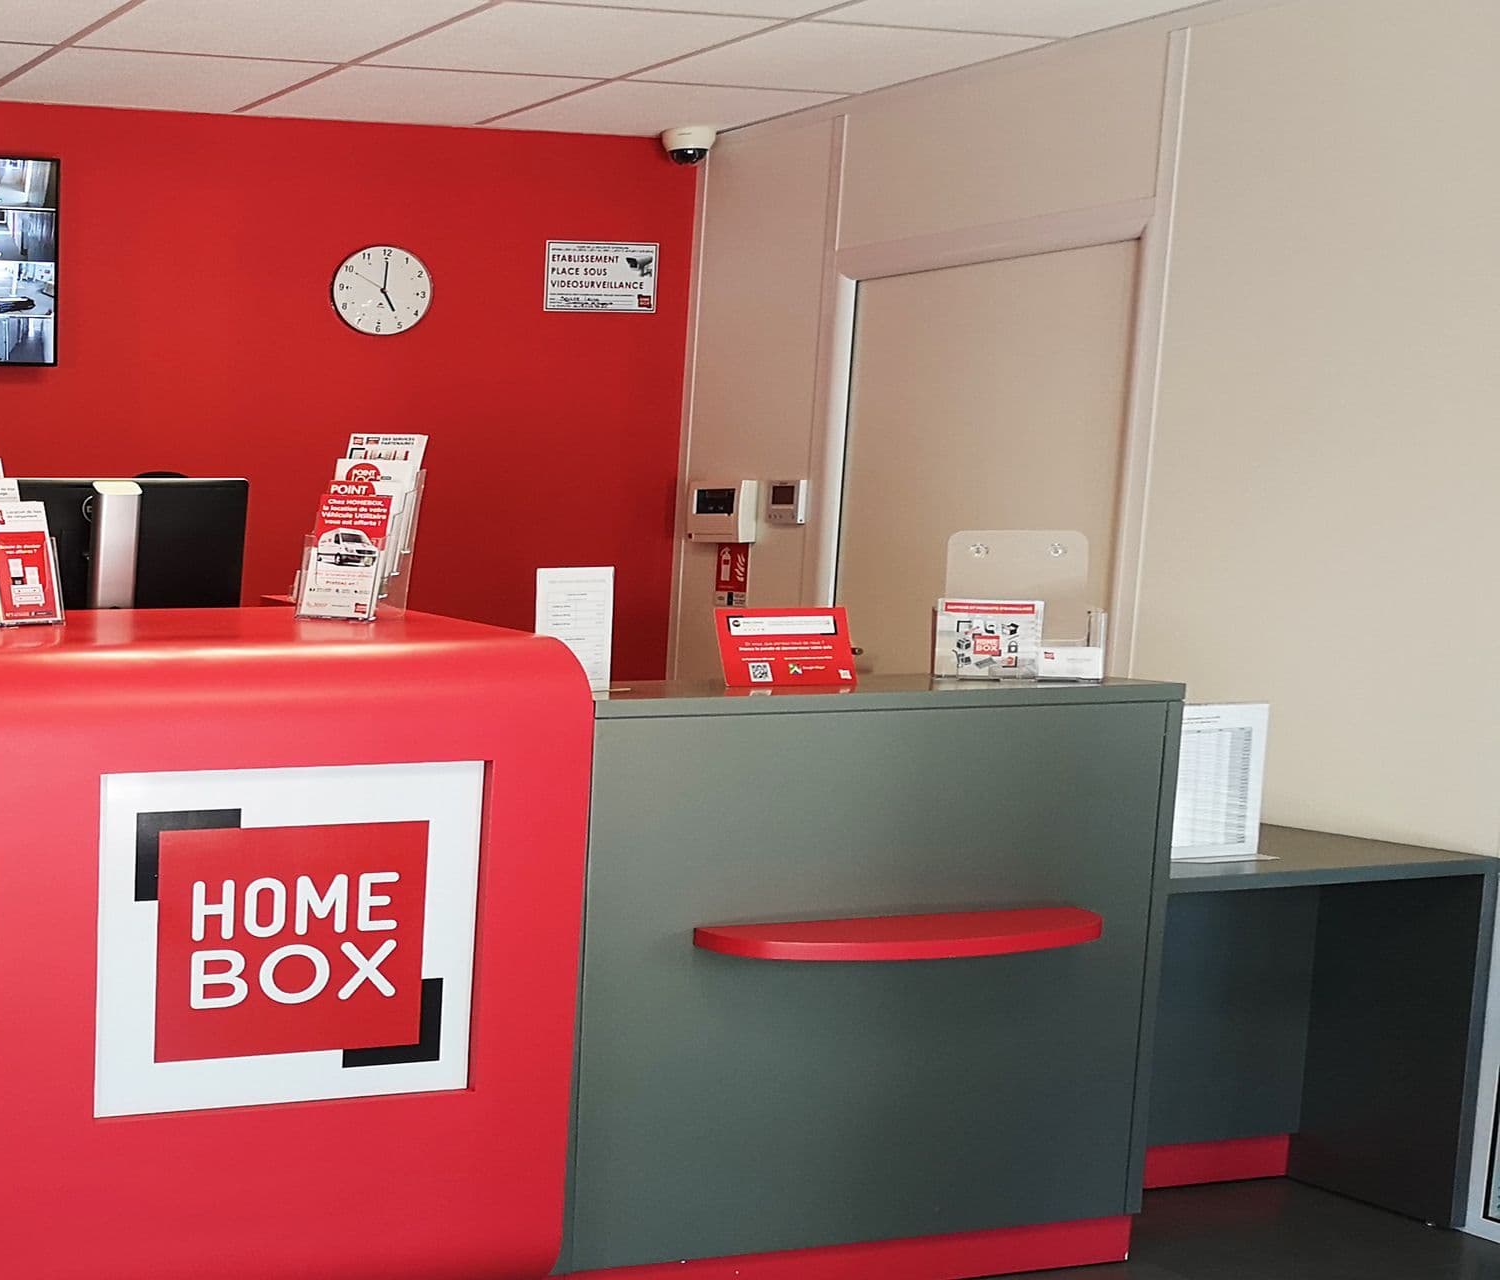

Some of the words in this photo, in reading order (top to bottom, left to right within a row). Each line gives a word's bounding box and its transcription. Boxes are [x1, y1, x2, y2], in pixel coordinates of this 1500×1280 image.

[362, 252, 371, 260] 11
[382, 249, 393, 257] 12
[551, 254, 619, 263] ETABLISSEMENT
[344, 265, 354, 273] 10
[551, 267, 580, 276] PLACE
[584, 267, 608, 276] SOUS
[417, 270, 423, 278] 2
[339, 283, 345, 291] 9
[550, 280, 644, 290] VIDEOSURVEILLANCE
[420, 291, 426, 299] 3
[341, 302, 348, 310] 8
[413, 309, 419, 317] 4
[375, 325, 381, 333] 6
[396, 321, 403, 329] 5
[329, 484, 368, 495] POINT
[191, 870, 400, 942] HOME
[189, 938, 398, 1010] BOX
